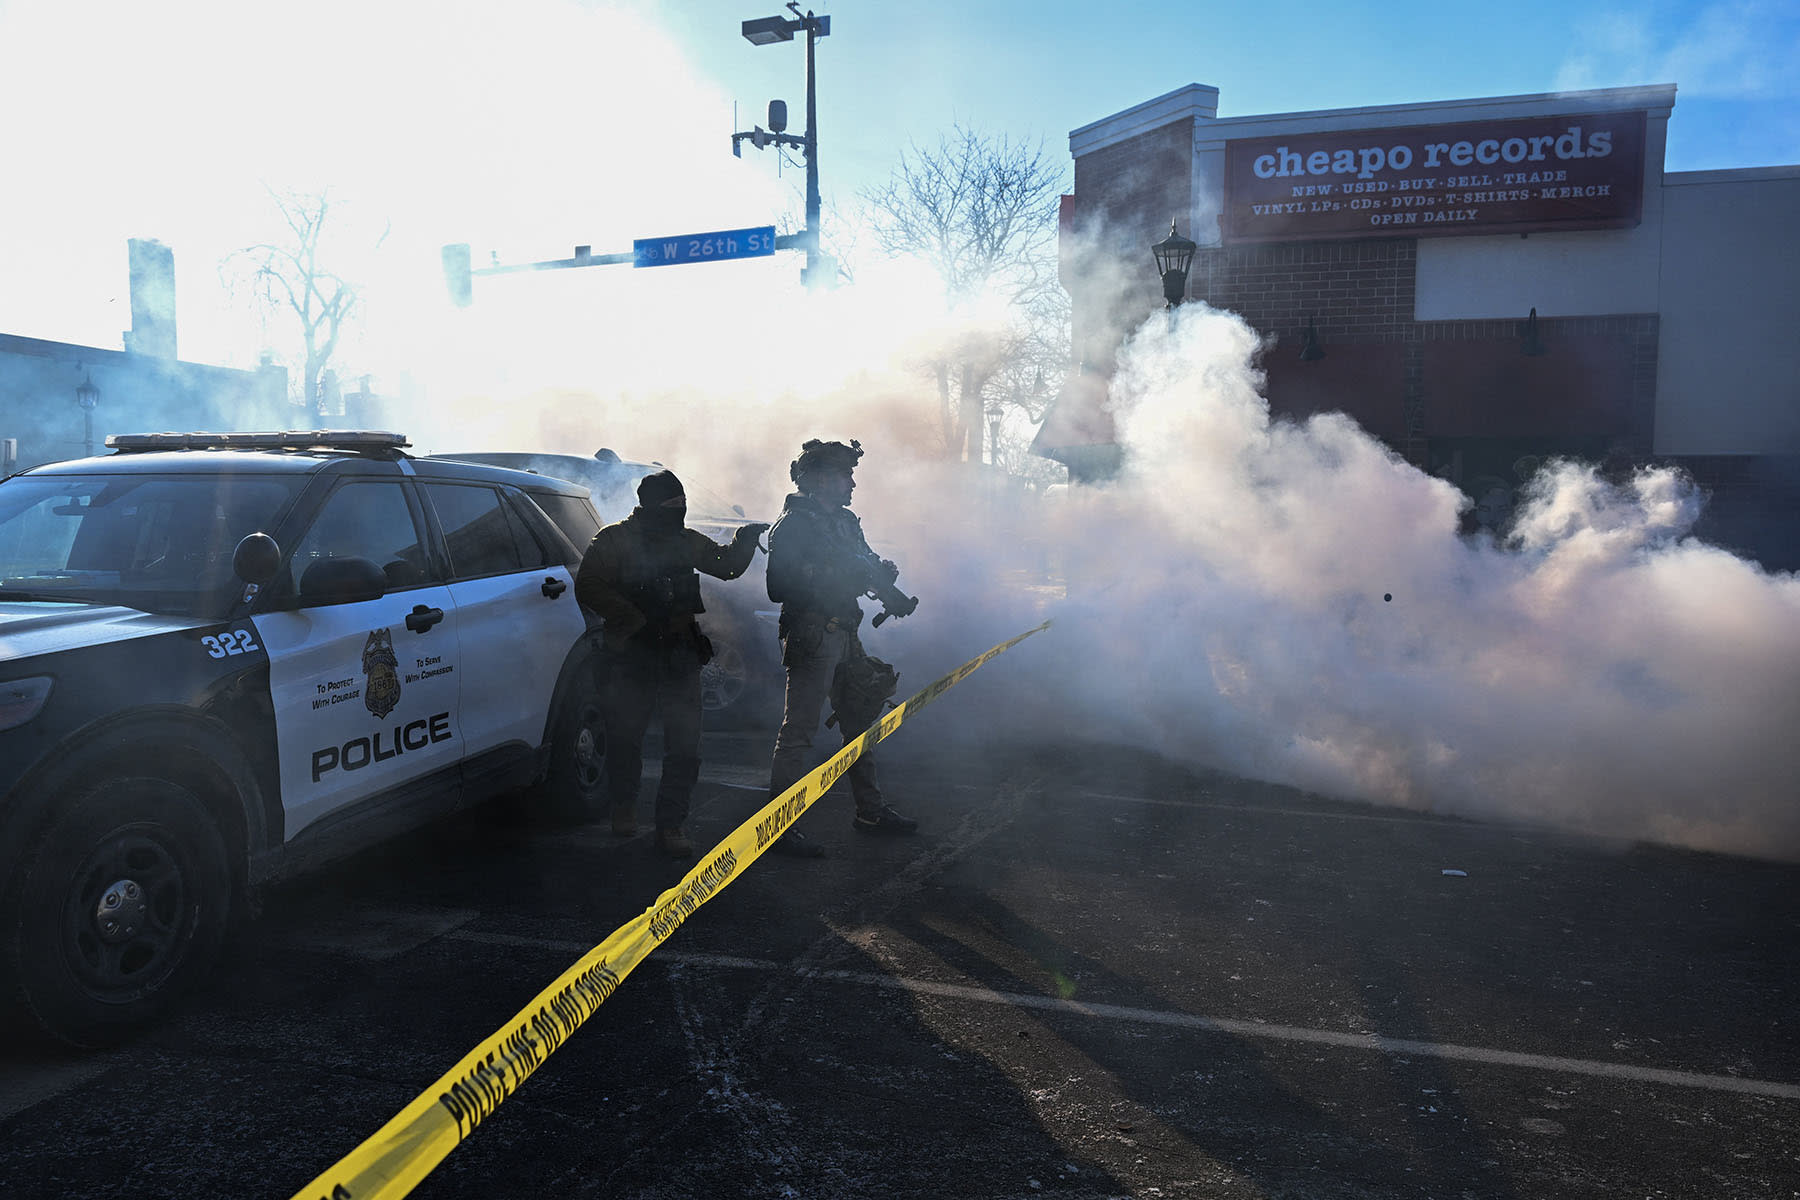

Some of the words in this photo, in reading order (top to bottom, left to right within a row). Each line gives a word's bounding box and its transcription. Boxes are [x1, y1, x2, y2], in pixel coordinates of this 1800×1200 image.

[1253, 144, 1413, 178] cheapo
[1423, 127, 1613, 168] records
[1291, 184, 1332, 197] NEW
[1342, 181, 1388, 194] USED
[1400, 177, 1435, 191] BUY
[1447, 175, 1492, 188] SELL
[1504, 171, 1567, 184] TRADE
[1252, 202, 1306, 216] VINYL
[1311, 200, 1340, 212] LPs
[1350, 198, 1381, 210] CDs
[1391, 195, 1435, 208] DVDs
[1446, 188, 1529, 204] T-SHIRTS
[1542, 185, 1610, 198] MERCH
[1371, 213, 1417, 225] OPEN
[1423, 209, 1478, 223] DAILY
[664, 243, 677, 259] W
[689, 239, 737, 257] 26th
[748, 234, 770, 251] St
[201, 629, 259, 659] 322
[312, 711, 452, 783] POLICE
[439, 1051, 510, 1142] POLICE
[498, 1024, 542, 1083] LINE
[531, 1006, 561, 1055] DO
[550, 983, 585, 1038] NOT
[575, 956, 620, 1015] CROSS
